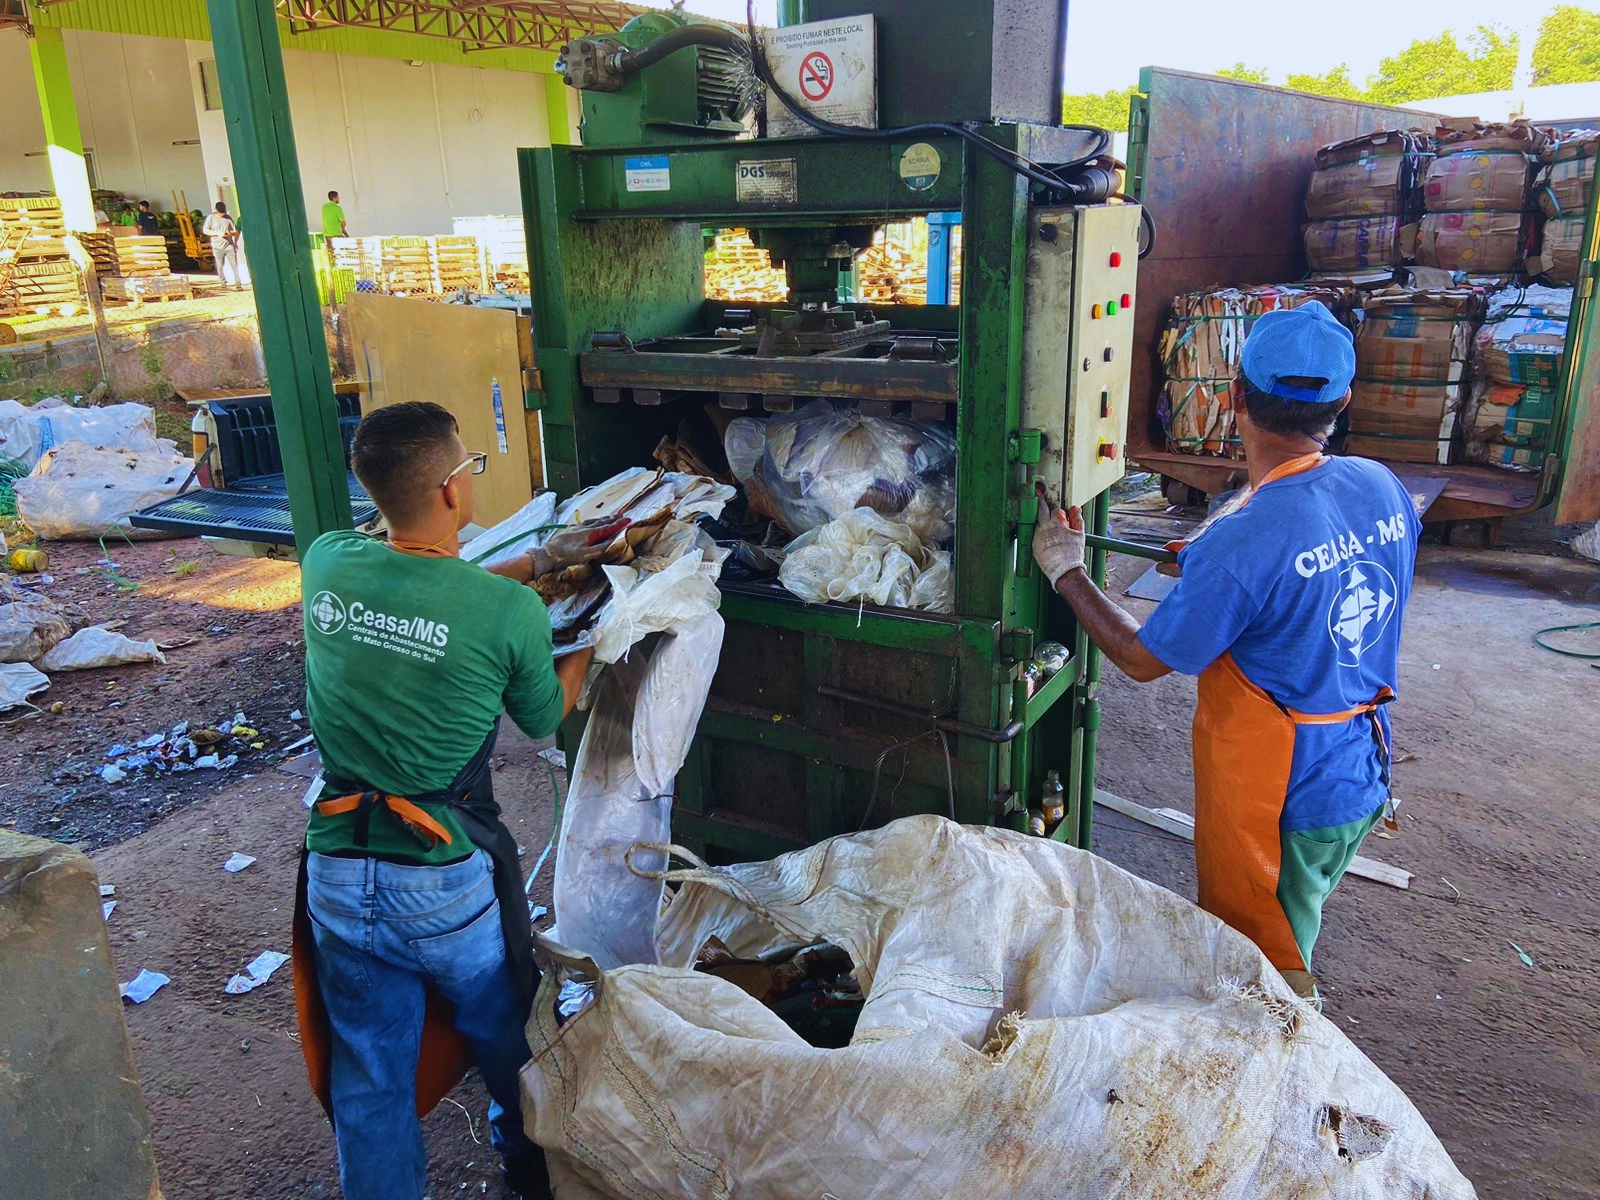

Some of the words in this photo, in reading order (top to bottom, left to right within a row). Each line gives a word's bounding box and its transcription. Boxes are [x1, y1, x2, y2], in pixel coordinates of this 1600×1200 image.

[776, 33, 802, 43] PROIBIDO
[803, 30, 823, 40] FUMAR
[823, 27, 843, 37] NESTE
[844, 24, 864, 34] LOCAL
[741, 166, 765, 178] DGS
[1294, 530, 1365, 578] CEASA
[1375, 512, 1406, 546] MS
[350, 601, 450, 647] Ceasa/MS
[347, 623, 378, 637] Centrais
[379, 631, 389, 640] de
[389, 634, 446, 657] Abastecimento
[352, 634, 362, 642] de
[363, 636, 382, 647] Mato
[383, 642, 410, 655] Grosso
[411, 650, 422, 659] do
[423, 653, 436, 663] Sul
